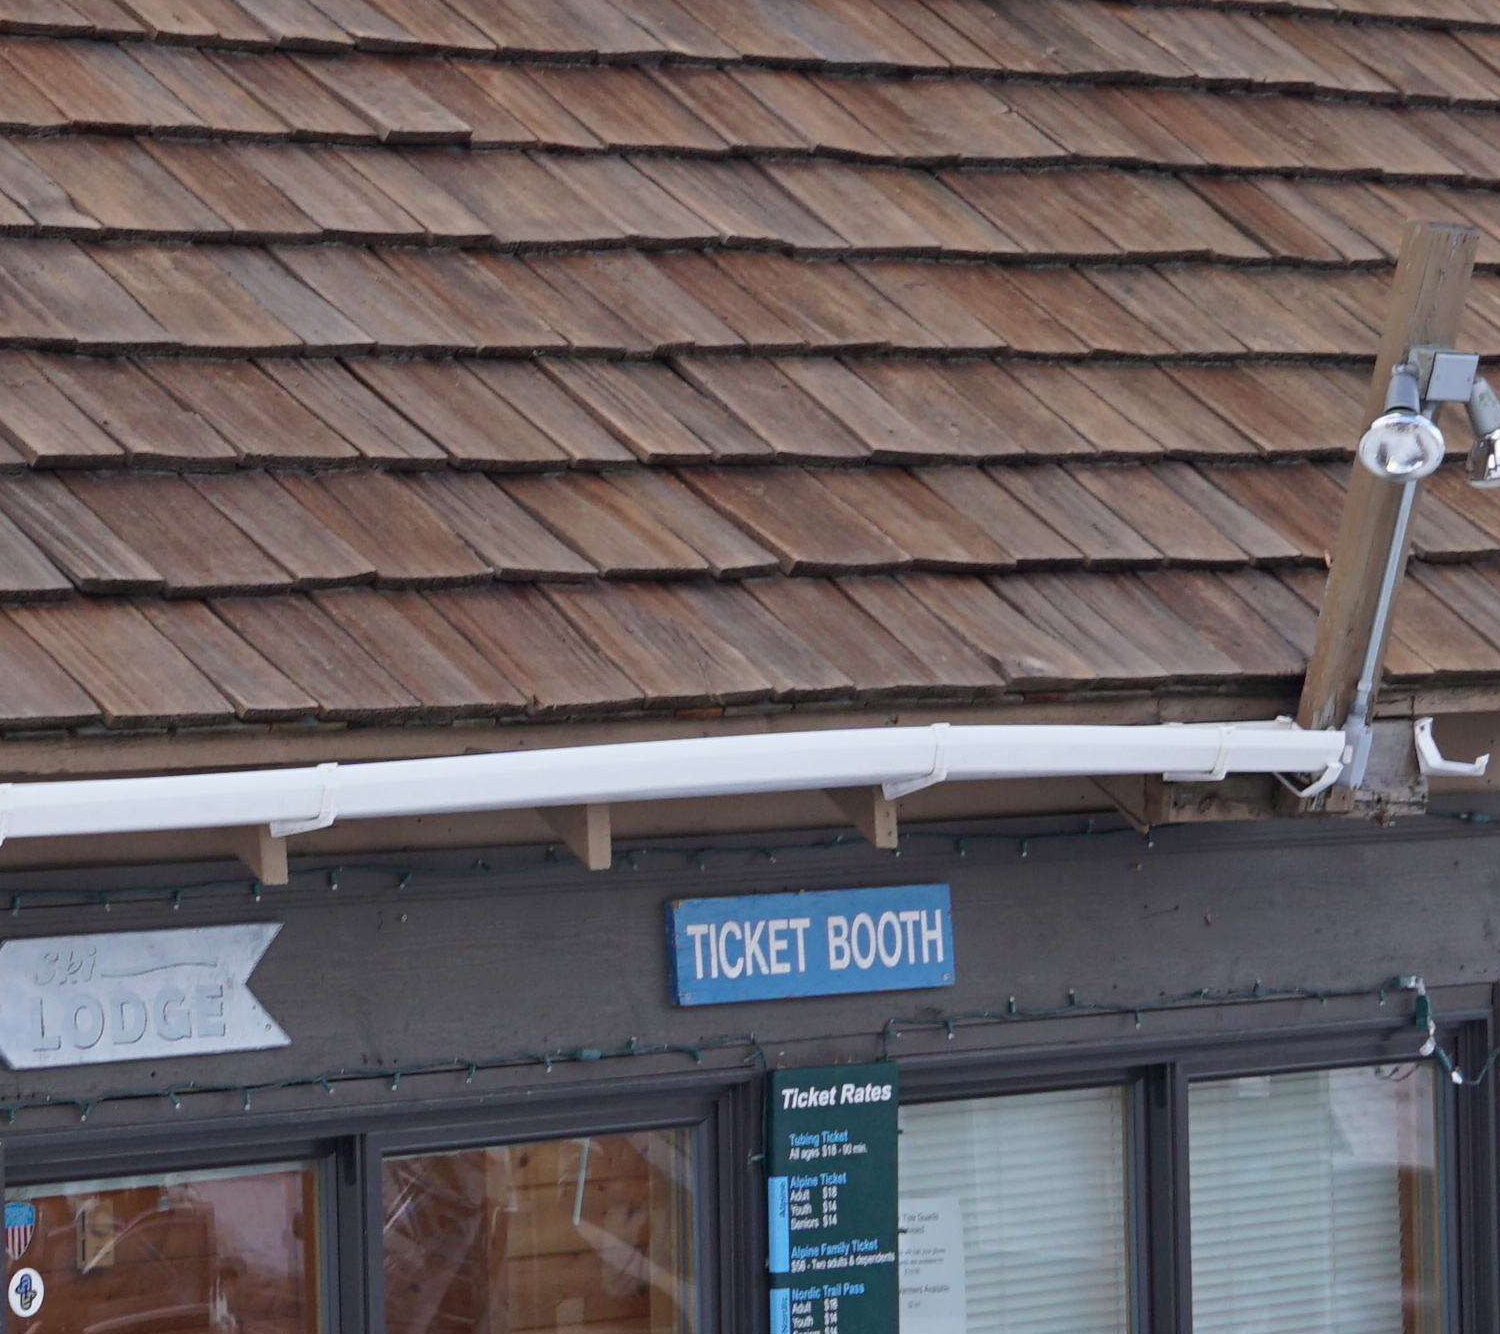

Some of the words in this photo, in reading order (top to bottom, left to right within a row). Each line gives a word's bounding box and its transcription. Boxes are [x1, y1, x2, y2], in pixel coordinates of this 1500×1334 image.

[686, 918, 810, 979] TICKET
[828, 908, 944, 970] BOOTH
[34, 946, 97, 987] Ski
[31, 984, 227, 1053] LODGE
[781, 1085, 837, 1110] Ticket
[840, 1083, 892, 1105] Rates
[789, 1132, 820, 1147] Tubing
[822, 1129, 848, 1143] Ticket
[789, 1148, 799, 1160] All
[801, 1149, 820, 1161] ages
[843, 1144, 852, 1155] 90
[853, 1142, 867, 1154] min.
[790, 1175, 818, 1189] Alpine
[820, 1172, 847, 1185] Ticket
[790, 1189, 810, 1203] Adult
[791, 1203, 812, 1216] Youth
[791, 1217, 819, 1231] Seniors
[791, 1245, 819, 1260] Alpine
[821, 1241, 850, 1256] Family
[852, 1239, 878, 1253] Ticket
[812, 1258, 826, 1270] Two
[827, 1257, 848, 1269] adults
[855, 1252, 895, 1266] dependents
[792, 1286, 821, 1301] Nordic
[823, 1284, 841, 1297] Trail
[844, 1282, 865, 1295] Pass
[792, 1301, 812, 1315] Adult
[792, 1315, 814, 1329] Youth
